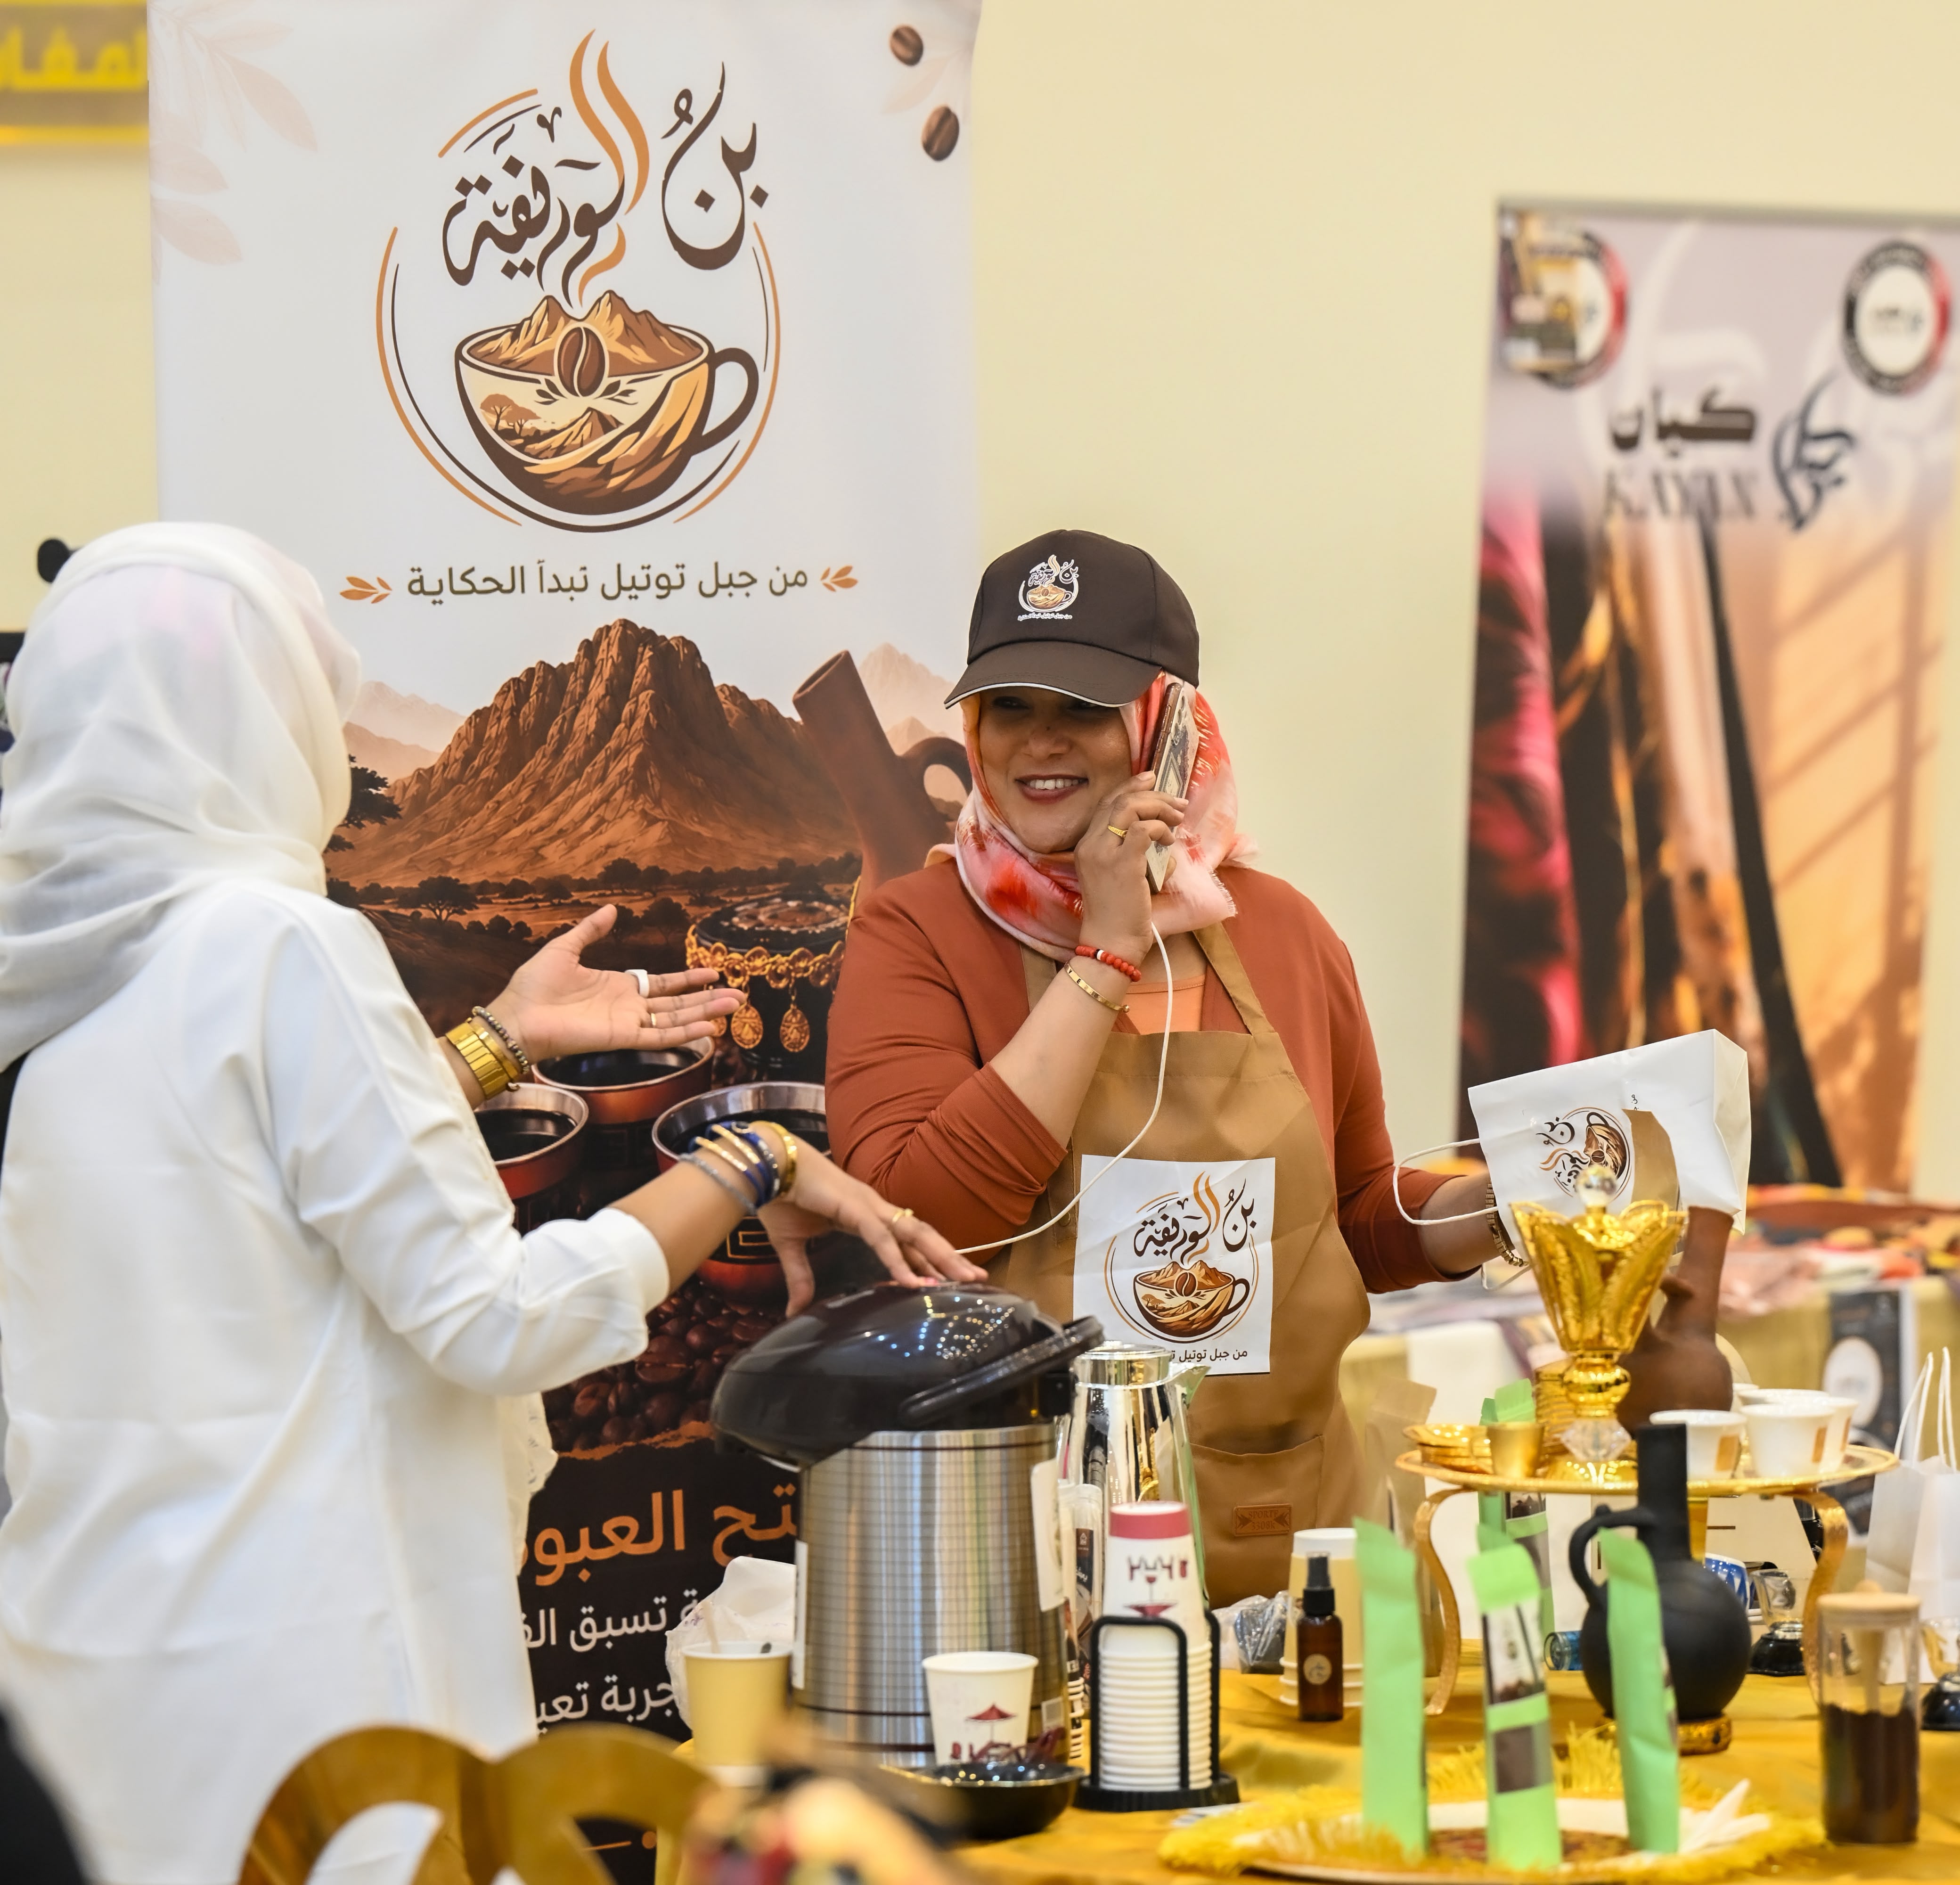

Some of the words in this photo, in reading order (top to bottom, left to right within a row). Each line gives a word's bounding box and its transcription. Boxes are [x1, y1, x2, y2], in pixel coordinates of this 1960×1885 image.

[407, 566, 525, 606] الحكاية
[601, 563, 685, 601] توتيل
[698, 561, 757, 598] جبل
[769, 566, 807, 596] من
[1179, 1350, 1207, 1362] توتيل
[1209, 1348, 1230, 1361] جبل
[1233, 1349, 1248, 1360] من
[521, 1489, 685, 1586] العبو
[570, 1596, 667, 1652] تسبق
[536, 1680, 589, 1734] تعي
[601, 1674, 674, 1723] جربة
